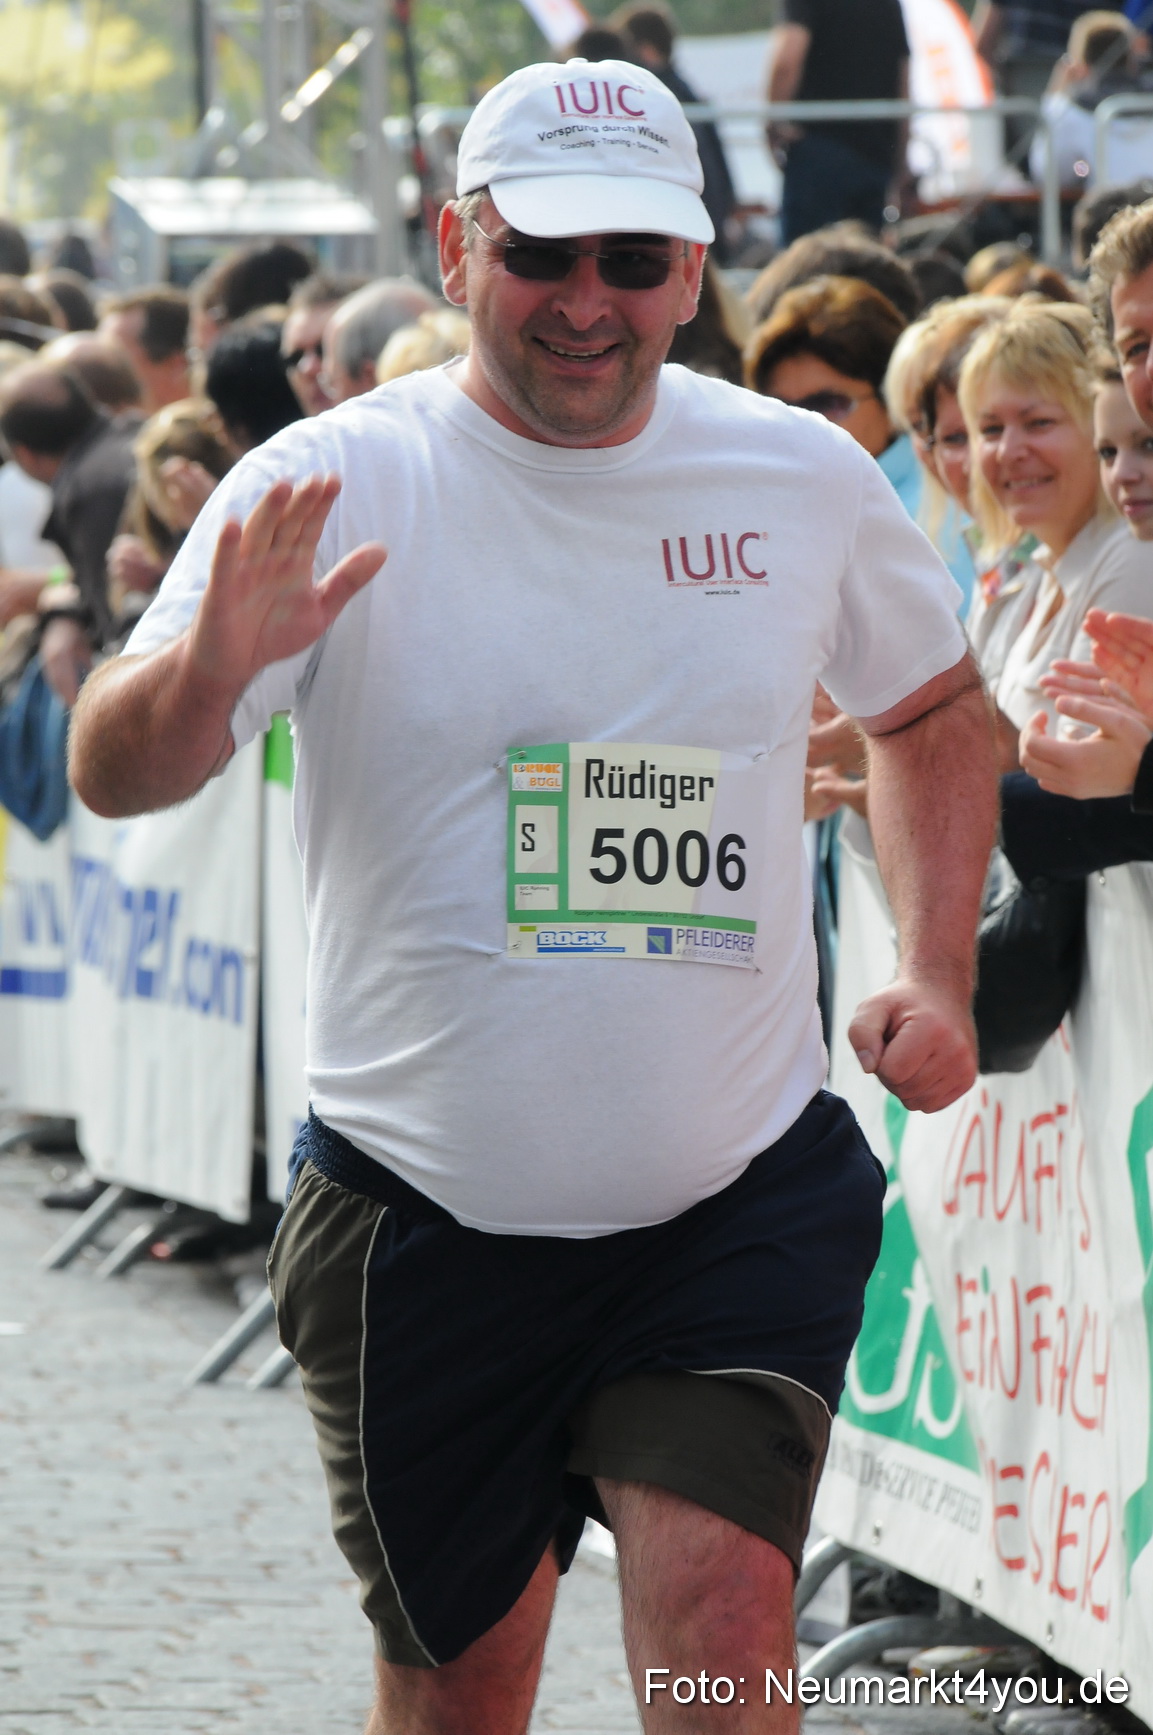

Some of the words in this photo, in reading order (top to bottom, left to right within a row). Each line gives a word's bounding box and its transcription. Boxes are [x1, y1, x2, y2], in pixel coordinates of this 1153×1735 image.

[554, 81, 645, 116] IUIC
[537, 125, 599, 142] Vorsprung
[602, 124, 635, 133] durch
[560, 139, 595, 151] Coaching
[601, 138, 631, 148] Training
[661, 532, 768, 581] IUIC
[584, 758, 715, 809] Rüdiger
[589, 827, 747, 892] 5006
[536, 930, 607, 946] BOCK
[676, 928, 755, 953] PFLEIDERER
